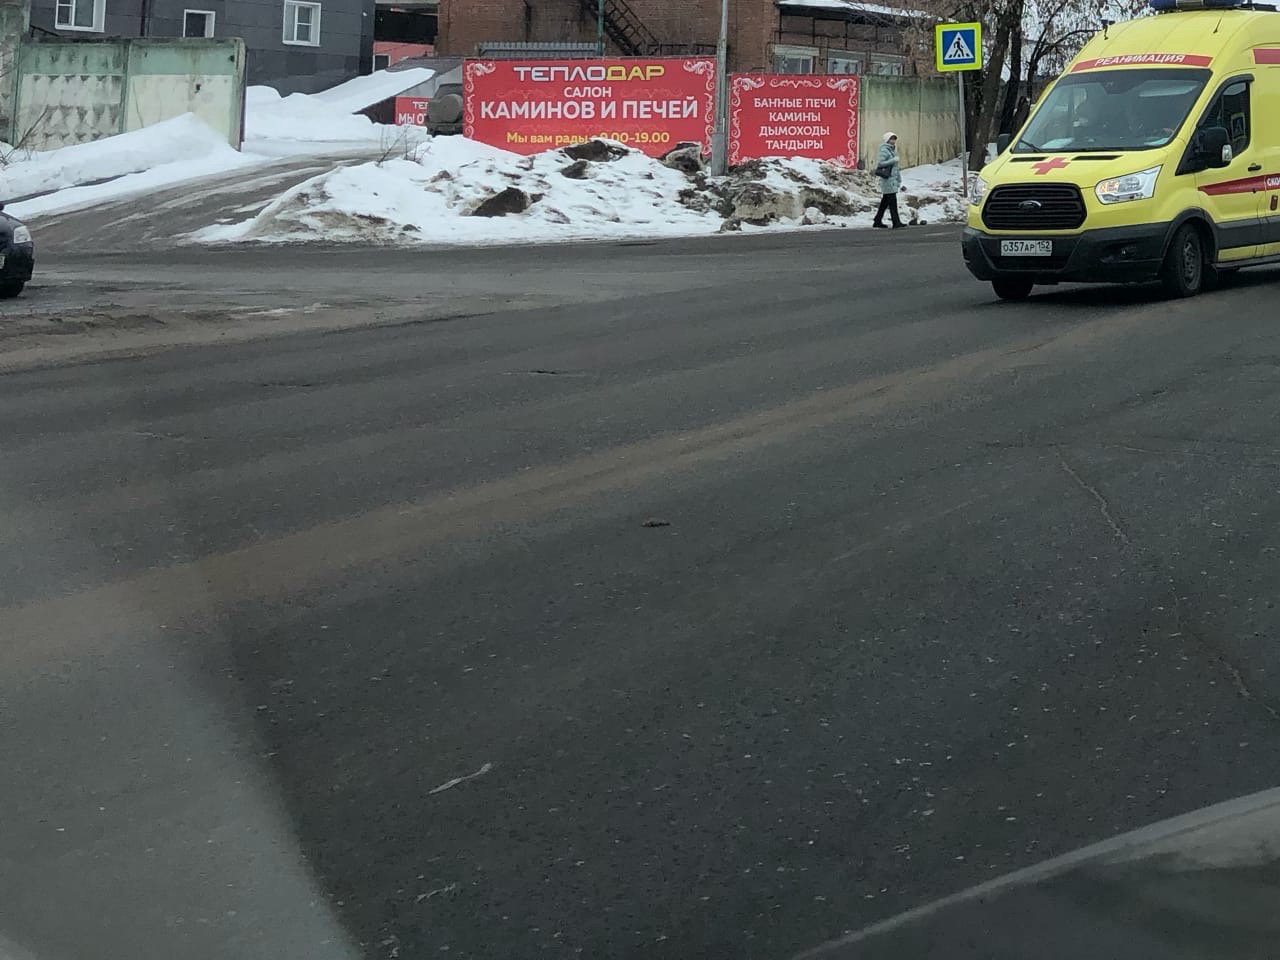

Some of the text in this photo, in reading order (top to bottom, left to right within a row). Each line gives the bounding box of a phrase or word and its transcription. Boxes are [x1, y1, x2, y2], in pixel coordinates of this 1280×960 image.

[1095, 54, 1186, 66] РЕАНИМАЦИЯ
[513, 65, 665, 81] ТЕПЛОДАР
[564, 86, 612, 97] САЛОН
[480, 96, 698, 119] КАМИНОВ И ПЕЧЕЙ
[754, 98, 836, 108] БАННЫЕ ПЕЧИ
[398, 113, 415, 125] МЫ
[769, 112, 821, 122] КАМИНЫ
[759, 126, 830, 137] ДЫМОХОДЫ
[506, 132, 527, 143] Мы
[530, 134, 552, 143] вам
[555, 134, 588, 146] рады
[766, 140, 823, 151] ТАНДЫРЫ
